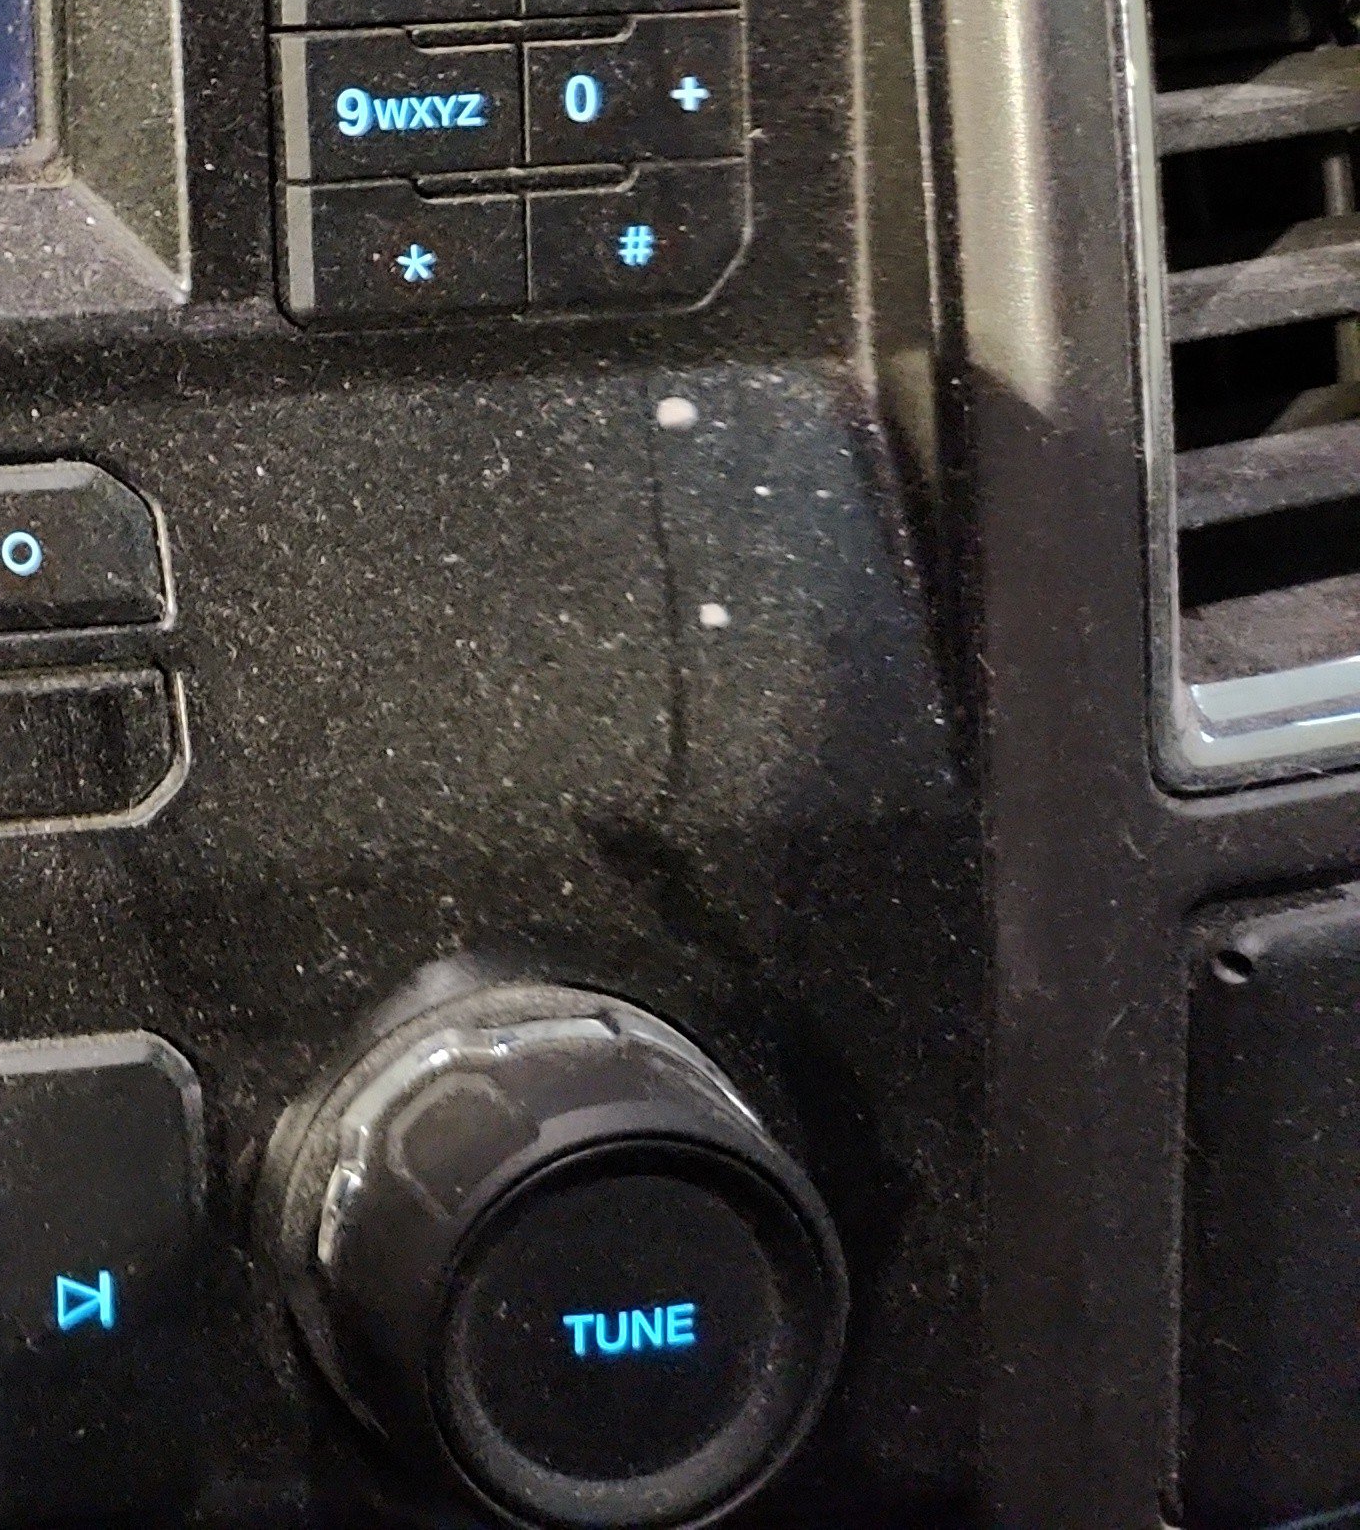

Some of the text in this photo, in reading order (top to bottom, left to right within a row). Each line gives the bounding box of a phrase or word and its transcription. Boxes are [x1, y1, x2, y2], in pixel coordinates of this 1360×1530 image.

[335, 86, 487, 138] 9 WXYZ
[563, 73, 603, 124] 0
[561, 1301, 697, 1358] TUNE
